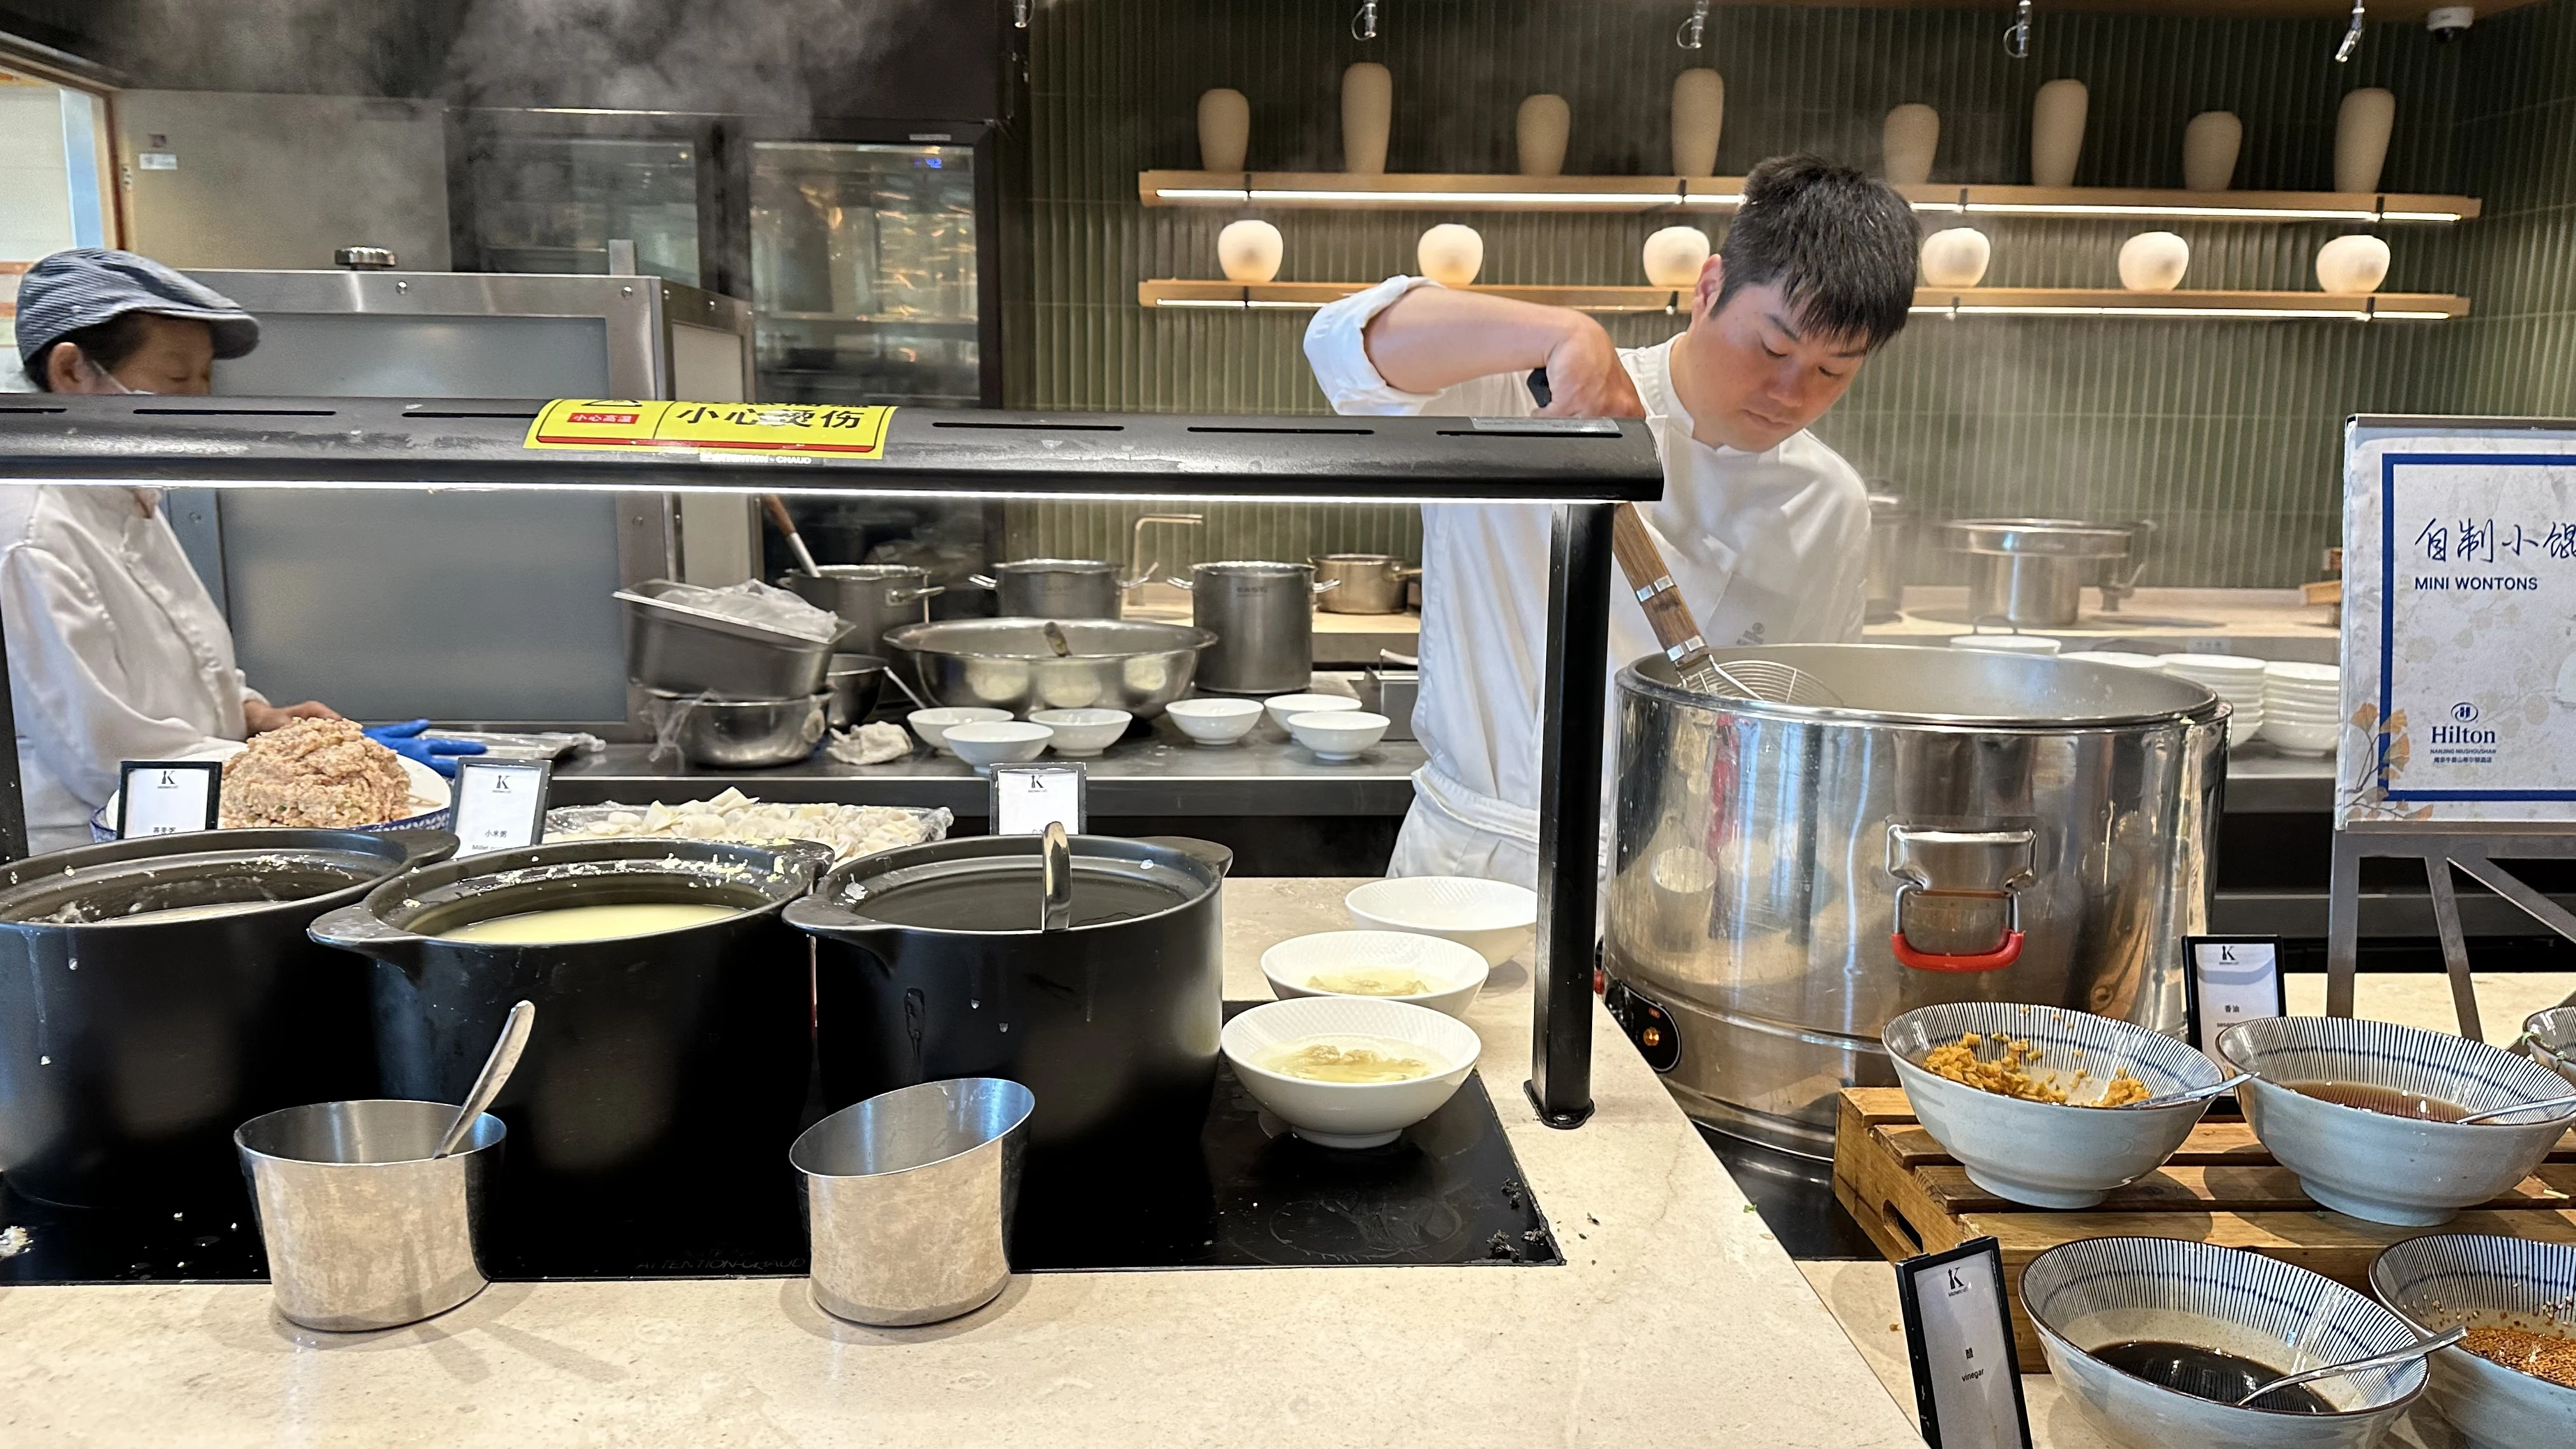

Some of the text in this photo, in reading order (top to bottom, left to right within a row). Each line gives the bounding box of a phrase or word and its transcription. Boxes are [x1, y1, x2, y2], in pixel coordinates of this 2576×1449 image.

[2415, 576, 2538, 590] MINI WONTONS
[2431, 725, 2496, 744] Hilton
[484, 829, 507, 838] 小米粥
[1961, 1368, 1984, 1382] vinegar
